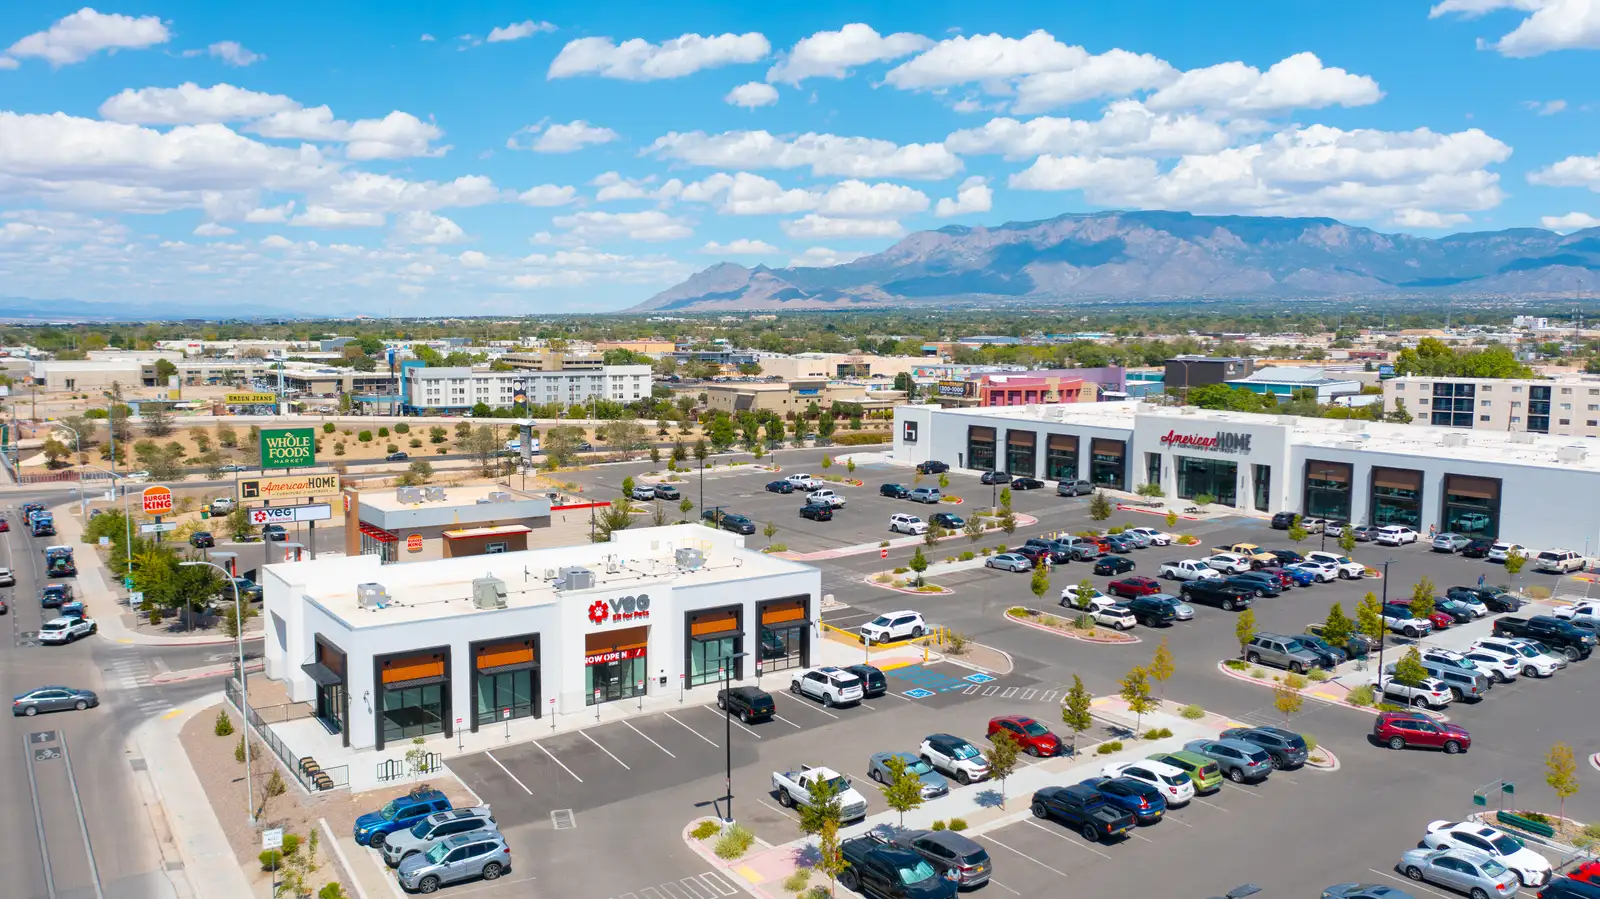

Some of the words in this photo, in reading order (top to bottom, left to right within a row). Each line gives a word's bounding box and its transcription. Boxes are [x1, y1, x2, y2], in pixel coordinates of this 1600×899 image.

[266, 436, 311, 448] WHOLE
[269, 447, 310, 458] FOODS
[144, 494, 171, 502] BURGER
[144, 500, 171, 509] KING
[604, 651, 628, 661] OPEN
